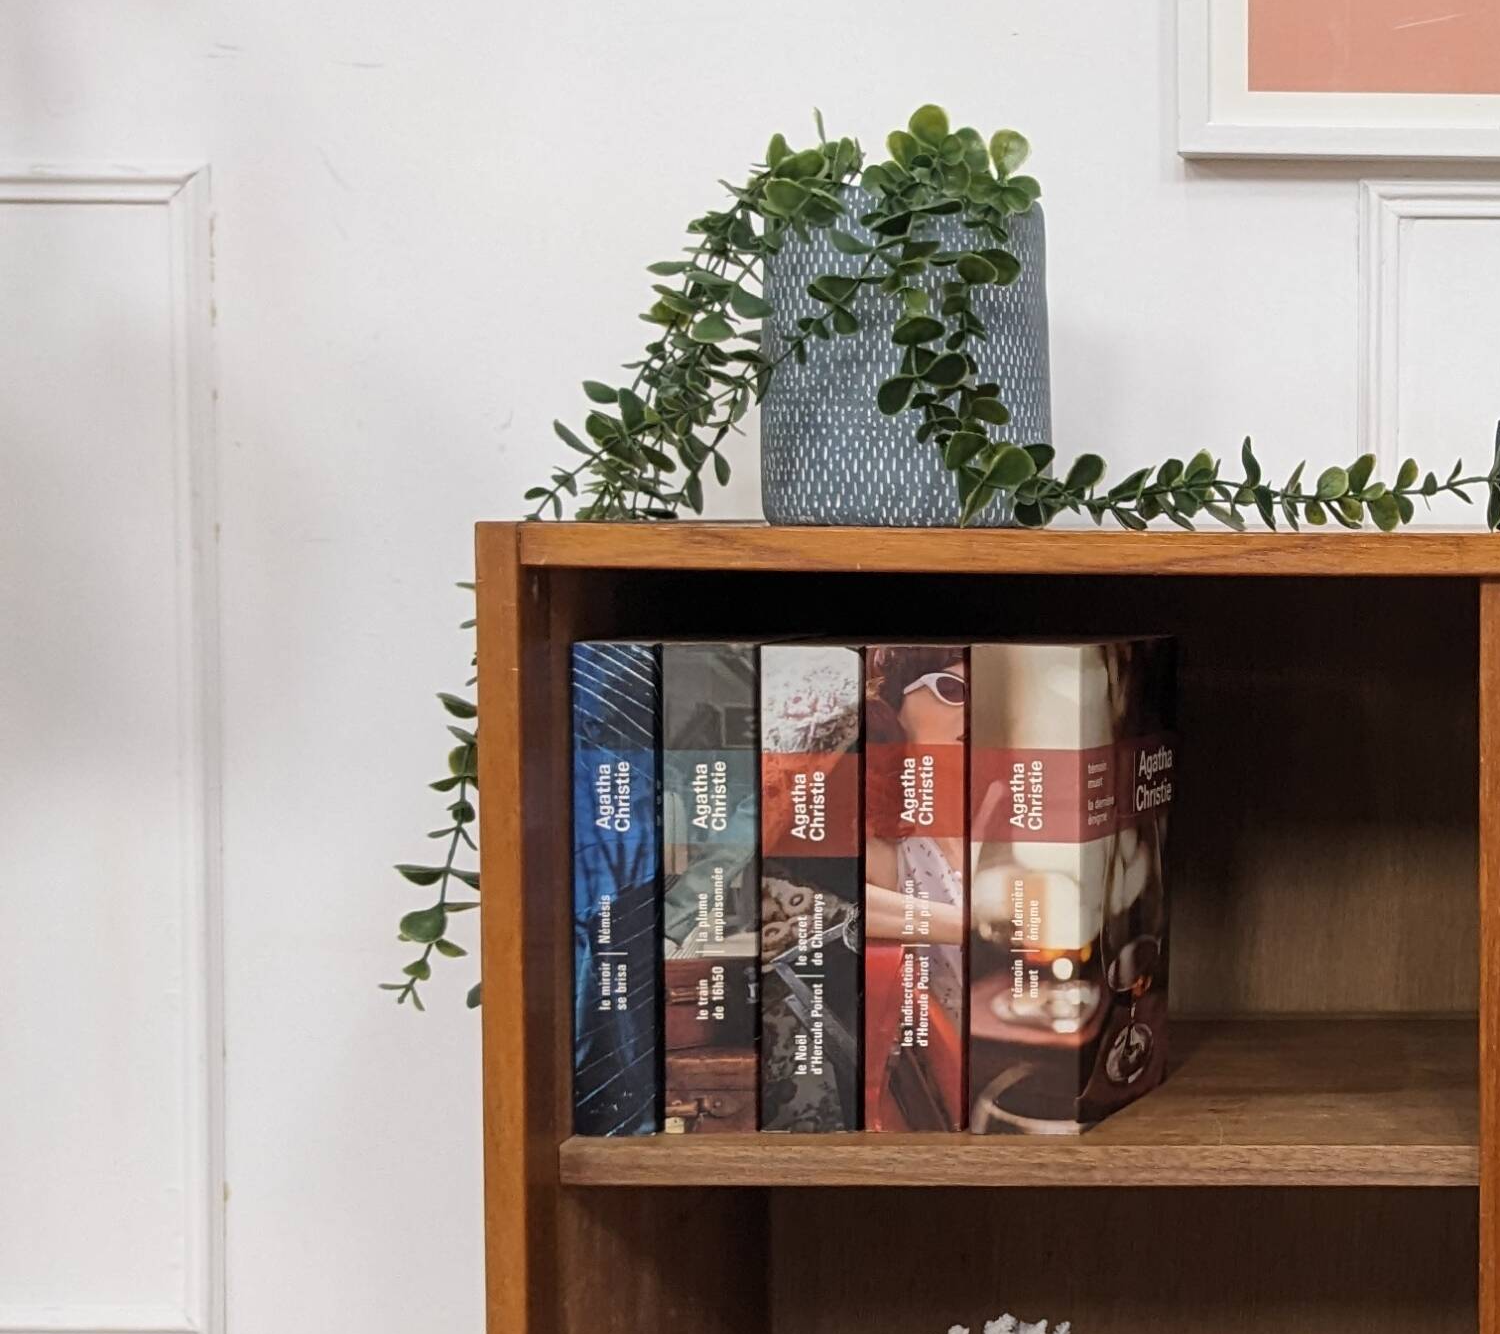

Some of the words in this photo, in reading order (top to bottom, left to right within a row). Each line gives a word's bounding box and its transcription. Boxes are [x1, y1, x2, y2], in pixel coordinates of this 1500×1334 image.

[1138, 745, 1173, 780] Agatha
[596, 764, 613, 830] Agatha
[614, 761, 630, 832] Christie
[693, 764, 710, 829] Agatha
[712, 761, 727, 831] Christie
[791, 774, 808, 839] Agatha
[810, 771, 825, 841] Christie
[901, 758, 918, 823] Agatha
[919, 756, 934, 825] Christie
[1010, 763, 1026, 828] Agatha
[1028, 761, 1043, 830] Christie
[1136, 777, 1172, 811] Christie
[697, 893, 711, 928] plume
[712, 867, 726, 942] empoisonnée
[902, 880, 914, 920] maison
[1012, 880, 1024, 926] dernière
[599, 895, 611, 944] Némésis
[697, 931, 708, 942] la
[797, 916, 807, 952] secret
[811, 894, 825, 949] Chimneys
[902, 923, 913, 935] la
[918, 922, 929, 935] du
[1013, 930, 1024, 940] la
[1027, 900, 1041, 940] énigme
[797, 955, 807, 965] le
[812, 952, 823, 965] de
[917, 956, 929, 990] Poirot
[599, 962, 611, 996] miroir
[616, 964, 627, 993] brisa
[697, 979, 708, 1006] train
[713, 966, 724, 1001] 16h50
[901, 954, 914, 1026] indiscrétions
[1012, 960, 1024, 998] témoin
[1029, 970, 1039, 998] muet
[599, 999, 611, 1010] le
[616, 997, 627, 1010] se
[697, 1009, 708, 1020] le
[713, 1006, 724, 1020] de
[812, 984, 823, 1018] Poirot
[917, 993, 929, 1046] d'Hercule
[795, 1035, 807, 1061] Noël
[812, 1022, 823, 1075] d'Hercule
[902, 1030, 913, 1046] les
[796, 1064, 807, 1075] le
